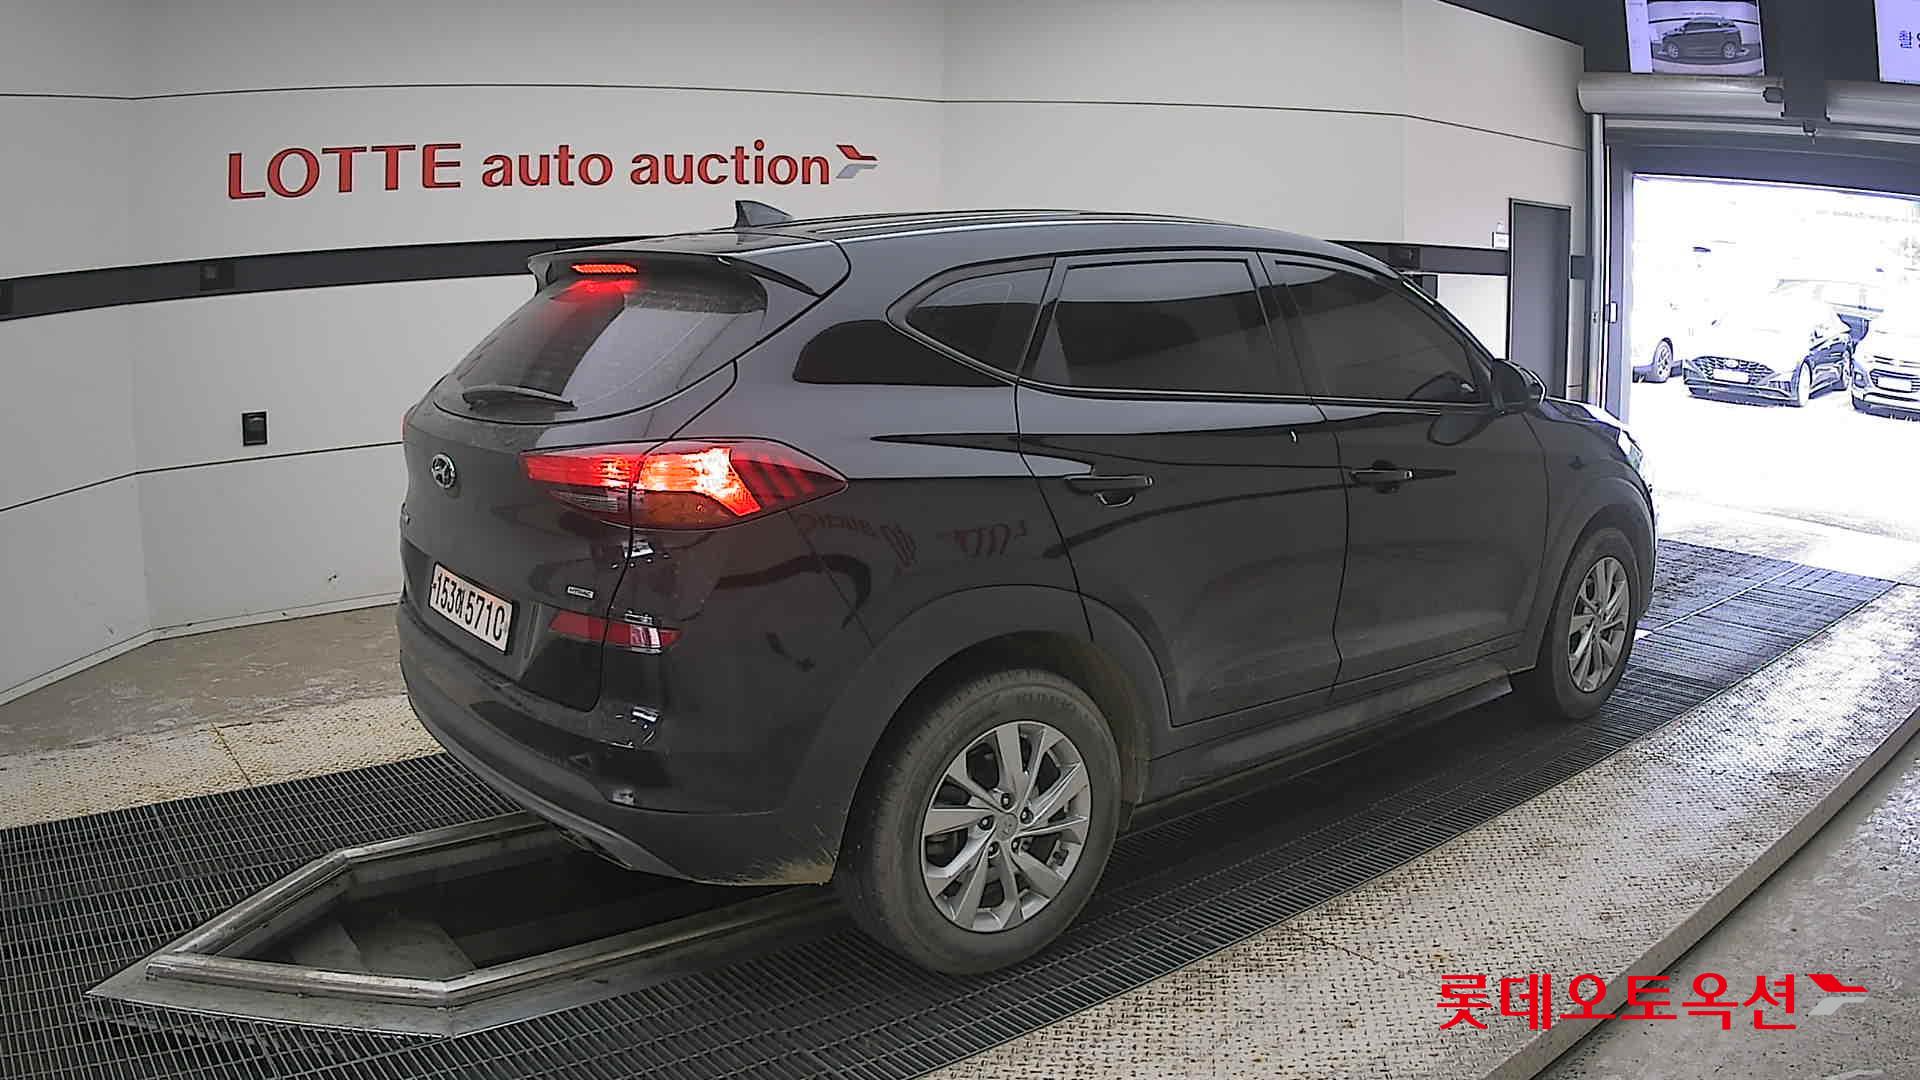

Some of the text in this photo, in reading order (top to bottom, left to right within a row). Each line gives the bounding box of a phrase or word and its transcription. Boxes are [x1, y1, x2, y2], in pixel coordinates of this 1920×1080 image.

[228, 140, 831, 200] LOTTE auto auction
